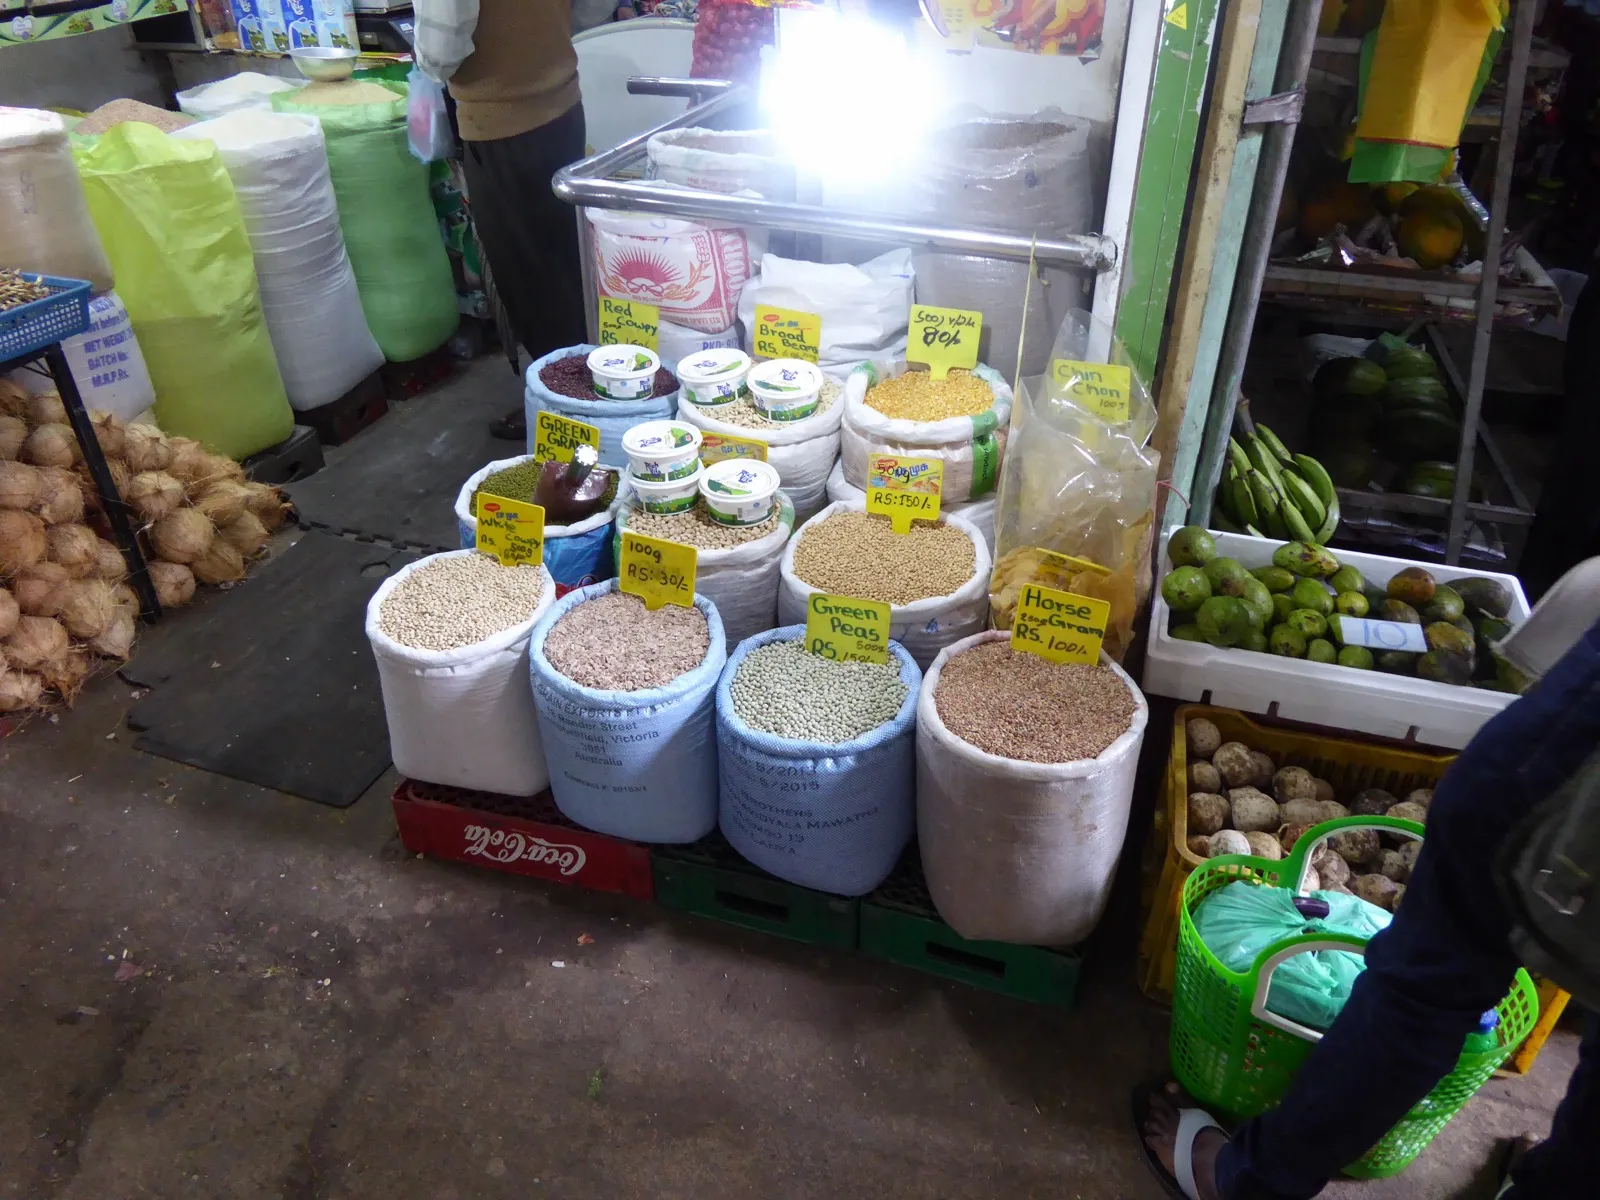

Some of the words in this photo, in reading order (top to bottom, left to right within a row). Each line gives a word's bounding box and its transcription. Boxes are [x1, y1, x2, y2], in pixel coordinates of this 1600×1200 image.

[604, 299, 632, 318] Red
[616, 316, 658, 336] Cowpy
[760, 324, 806, 344] Broad
[88, 354, 117, 371] BATCH
[540, 415, 591, 442] GREEN
[629, 540, 662, 563] 100g
[812, 596, 879, 621] Green
[1025, 588, 1091, 620] Horse
[830, 616, 880, 642] Peas
[1048, 613, 1104, 638] Gram
[1362, 619, 1408, 648] 10
[600, 720, 638, 733] Street
[609, 730, 660, 743] Victoria
[574, 751, 623, 767] Australia
[463, 824, 587, 876] Coca-Cola
